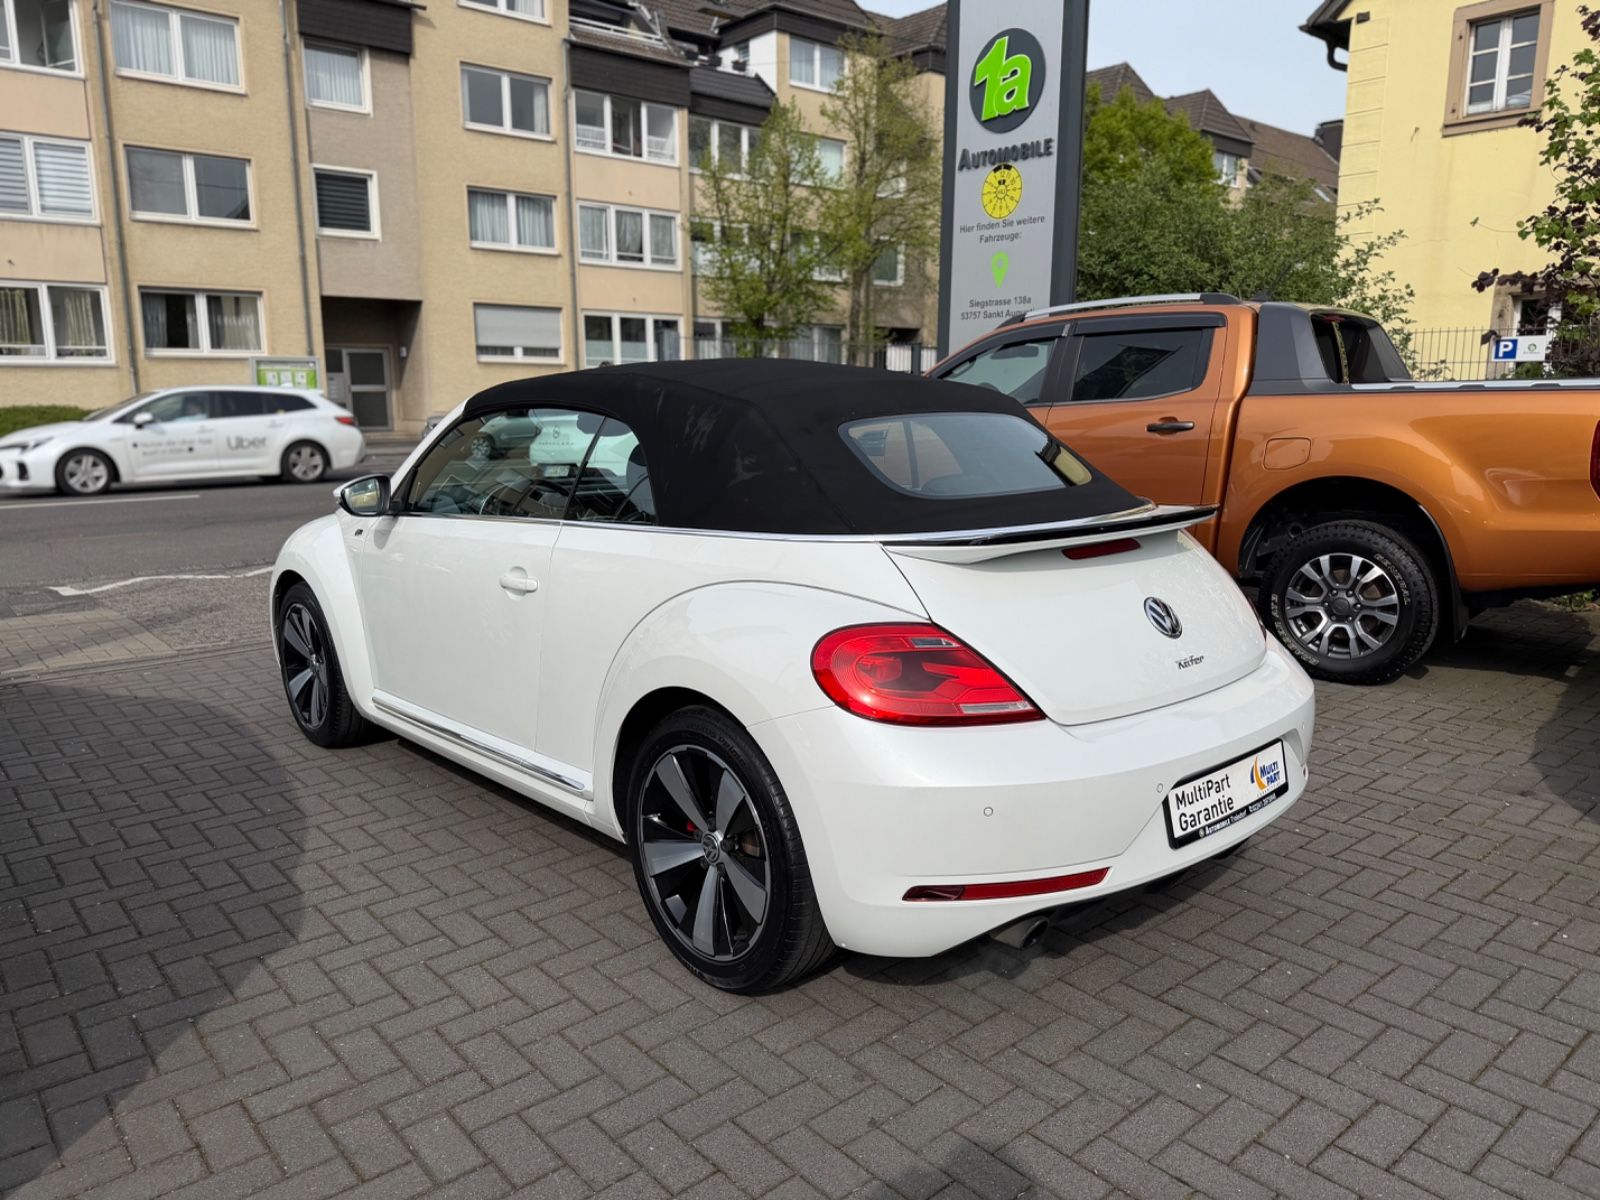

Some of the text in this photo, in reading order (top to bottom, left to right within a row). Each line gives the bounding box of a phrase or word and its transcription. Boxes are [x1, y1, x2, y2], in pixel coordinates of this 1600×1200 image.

[974, 36, 1032, 121] 1a
[960, 215, 1046, 234] Hier finden Sie weitere
[979, 231, 1022, 244] Fahrzeuge:
[969, 295, 1032, 309] Siegstrasse 138a
[961, 310, 982, 321] 53757
[983, 309, 1004, 319] Sankt
[1498, 341, 1514, 358] P
[226, 435, 267, 450] Uber
[1260, 760, 1279, 779] MULTI
[1266, 770, 1280, 787] PART
[1175, 773, 1231, 811] MultiPart
[1179, 794, 1235, 832] Garantie
